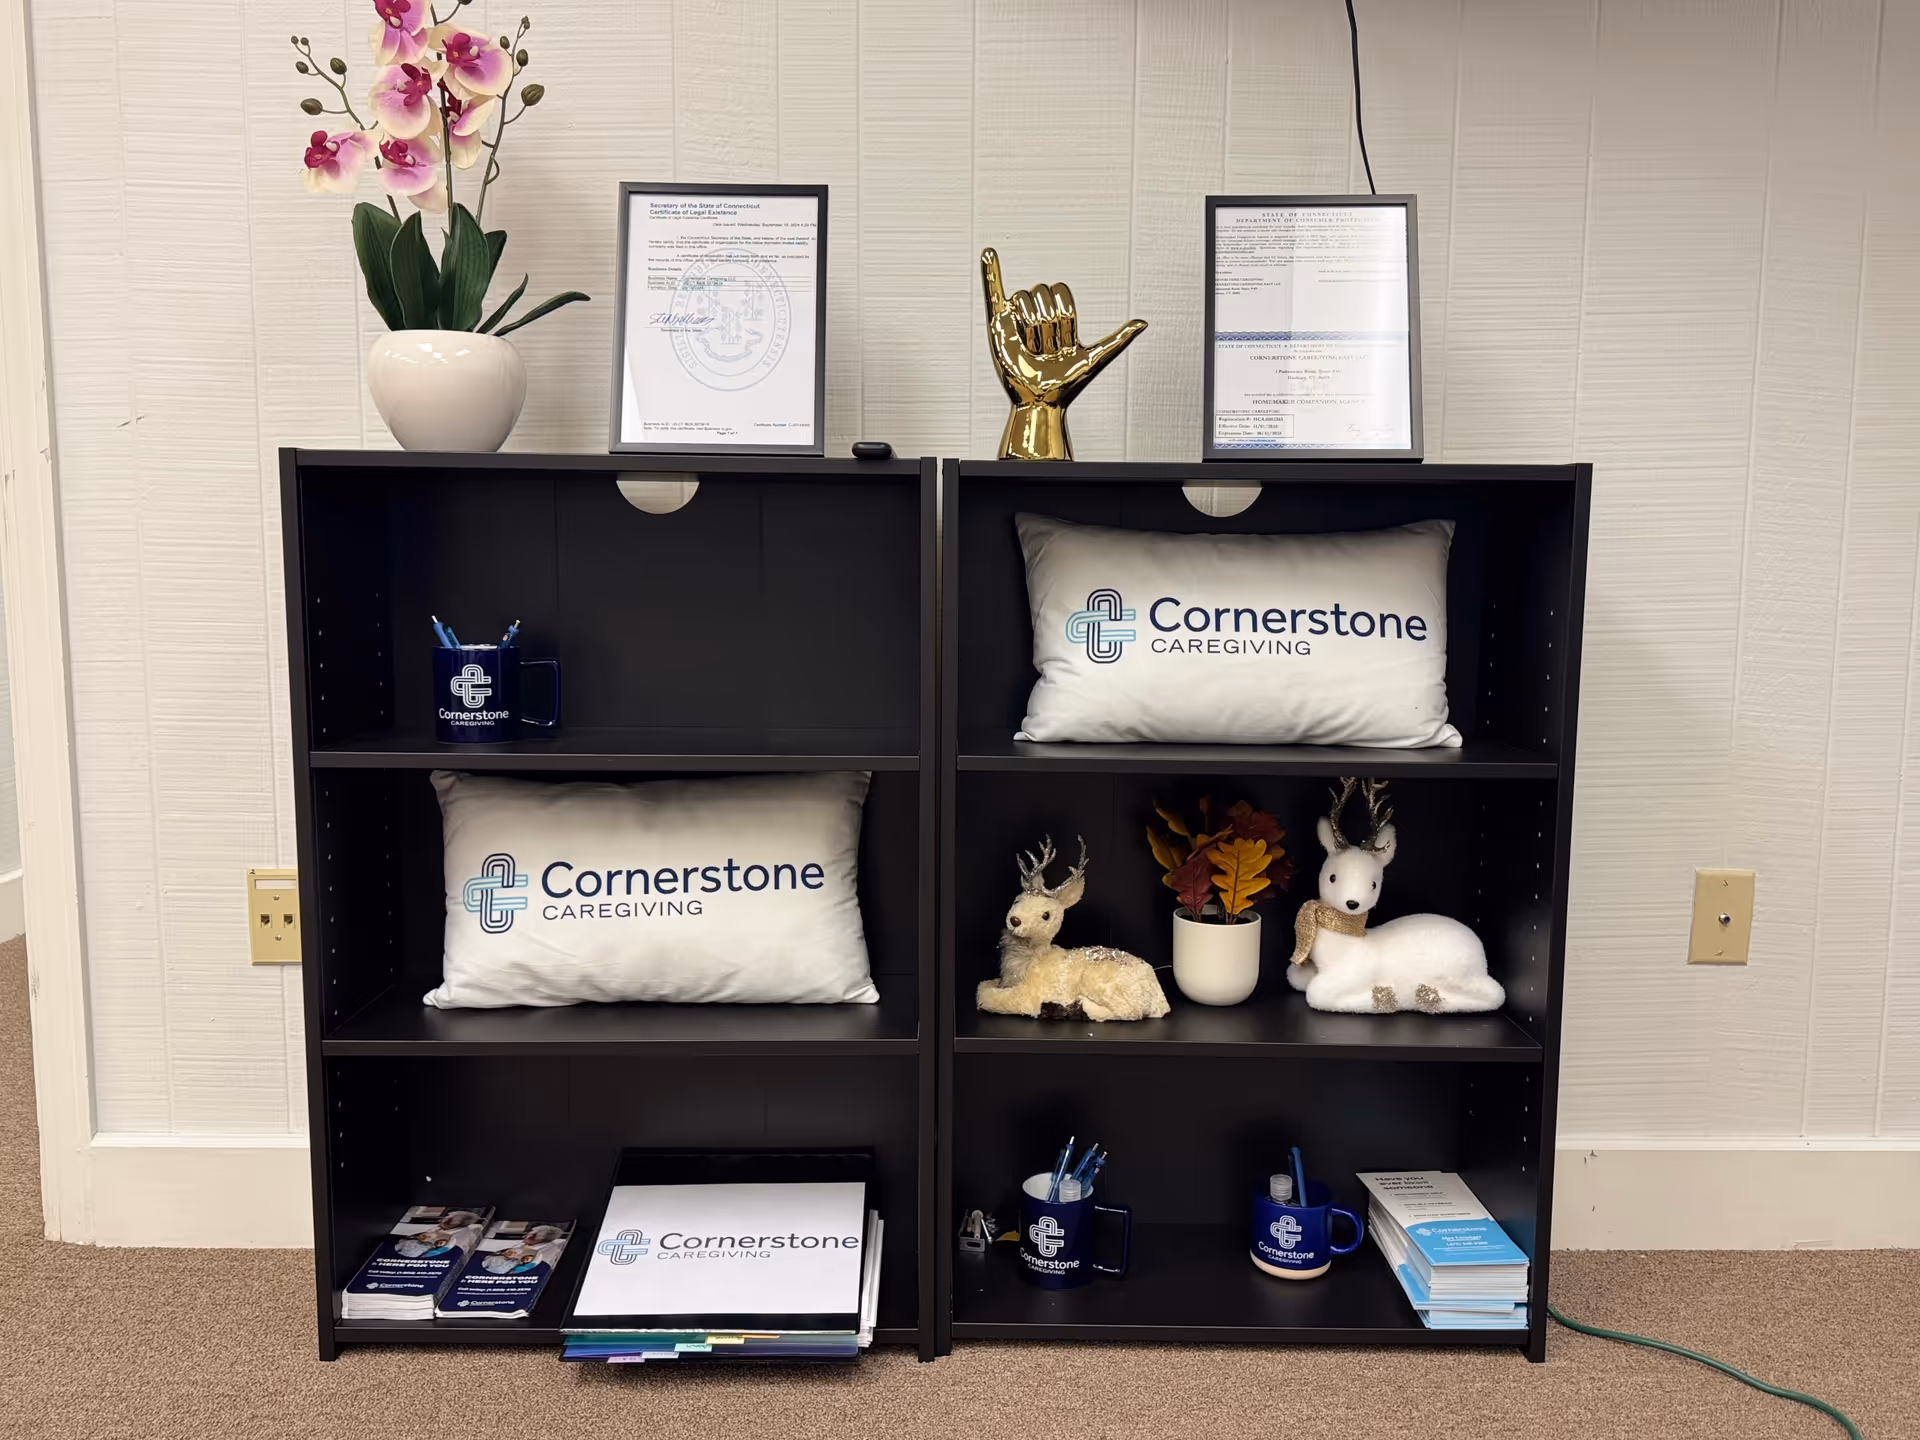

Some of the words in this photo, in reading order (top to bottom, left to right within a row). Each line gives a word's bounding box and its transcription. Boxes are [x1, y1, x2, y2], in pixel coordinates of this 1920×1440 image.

[1149, 597, 1428, 642] Cornerstone
[1151, 638, 1312, 656] CAREGIVING
[439, 708, 509, 720] Cornerstone
[542, 858, 825, 898] Cornerstone
[542, 900, 703, 920] CAREGIVING
[659, 1232, 860, 1250] Cornerstone
[1258, 1241, 1314, 1259] Cornerstone
[656, 1251, 771, 1260] CAREGIVING
[1020, 1247, 1080, 1270] Cornerstone
[1268, 1254, 1302, 1264] CAREGIVING
[1028, 1263, 1065, 1275] CAREGIVING
